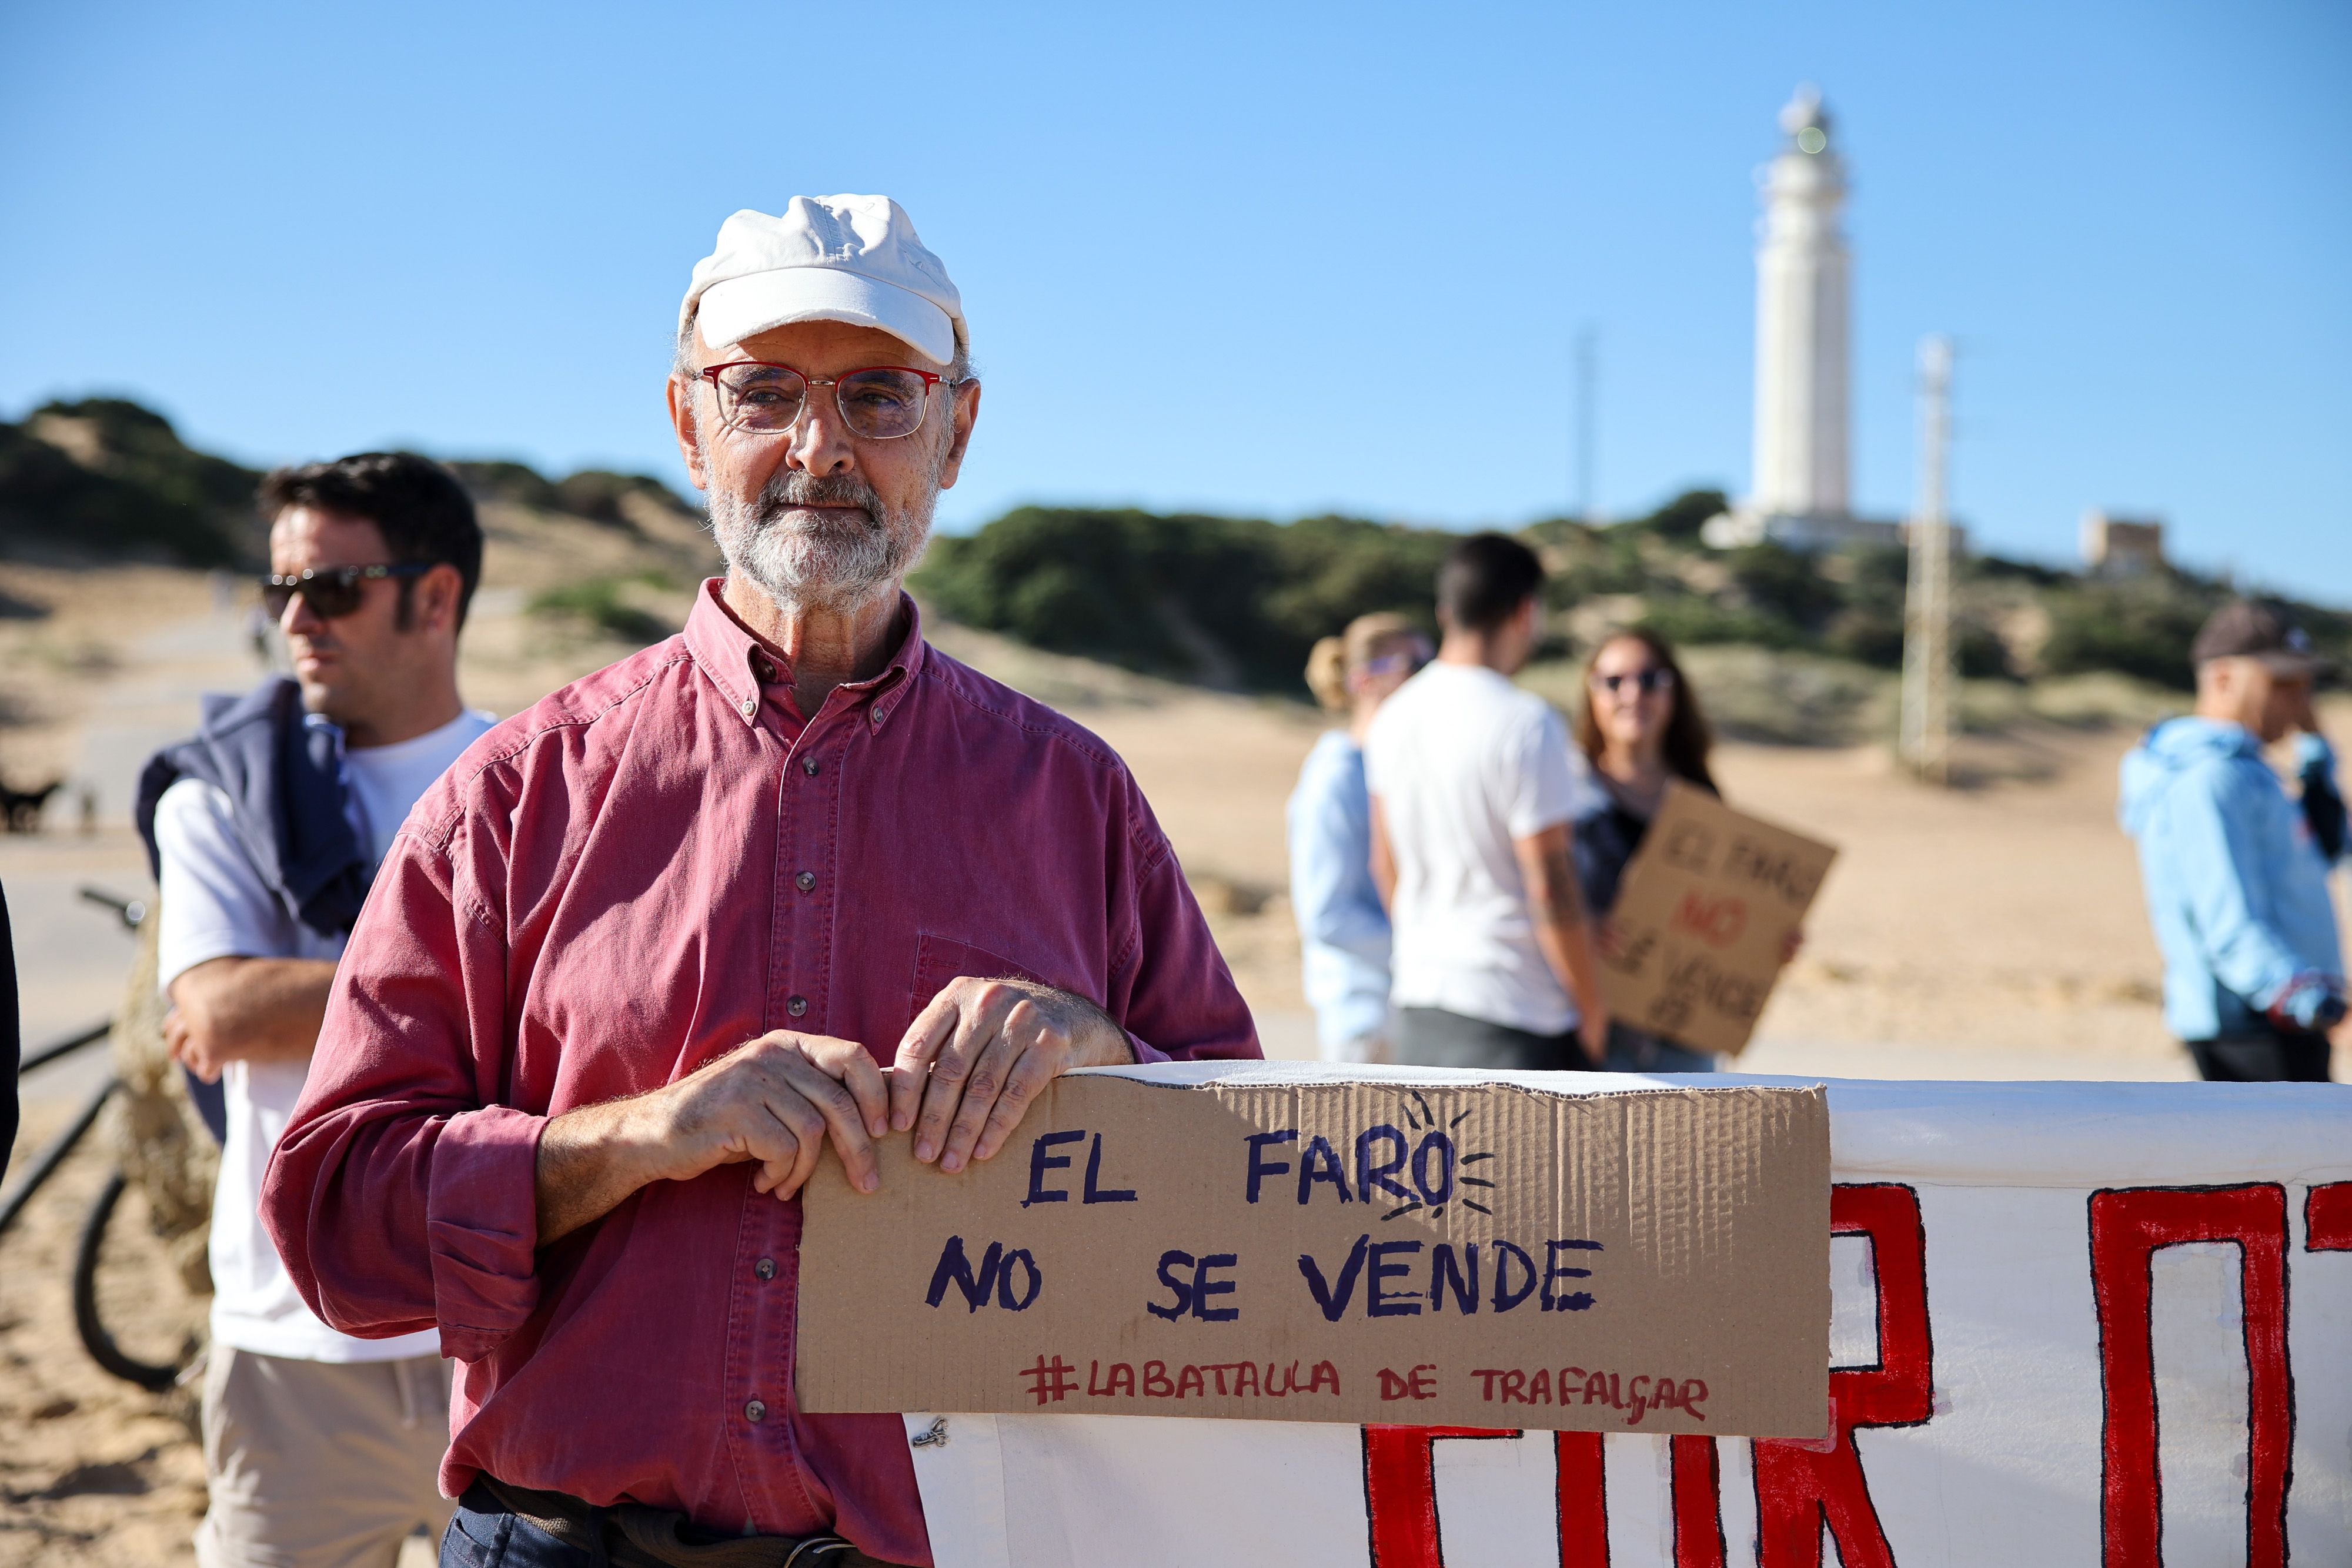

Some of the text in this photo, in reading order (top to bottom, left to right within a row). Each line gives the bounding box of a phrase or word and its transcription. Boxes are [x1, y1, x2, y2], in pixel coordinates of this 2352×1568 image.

[1671, 884, 1749, 950] NO
[1022, 1124, 1455, 1206] EL FARO
[927, 1235, 1602, 1323] NO SE VENDE
[1376, 1364, 1436, 1400] DE
[1471, 1366, 1709, 1425] TRAFALGAR
